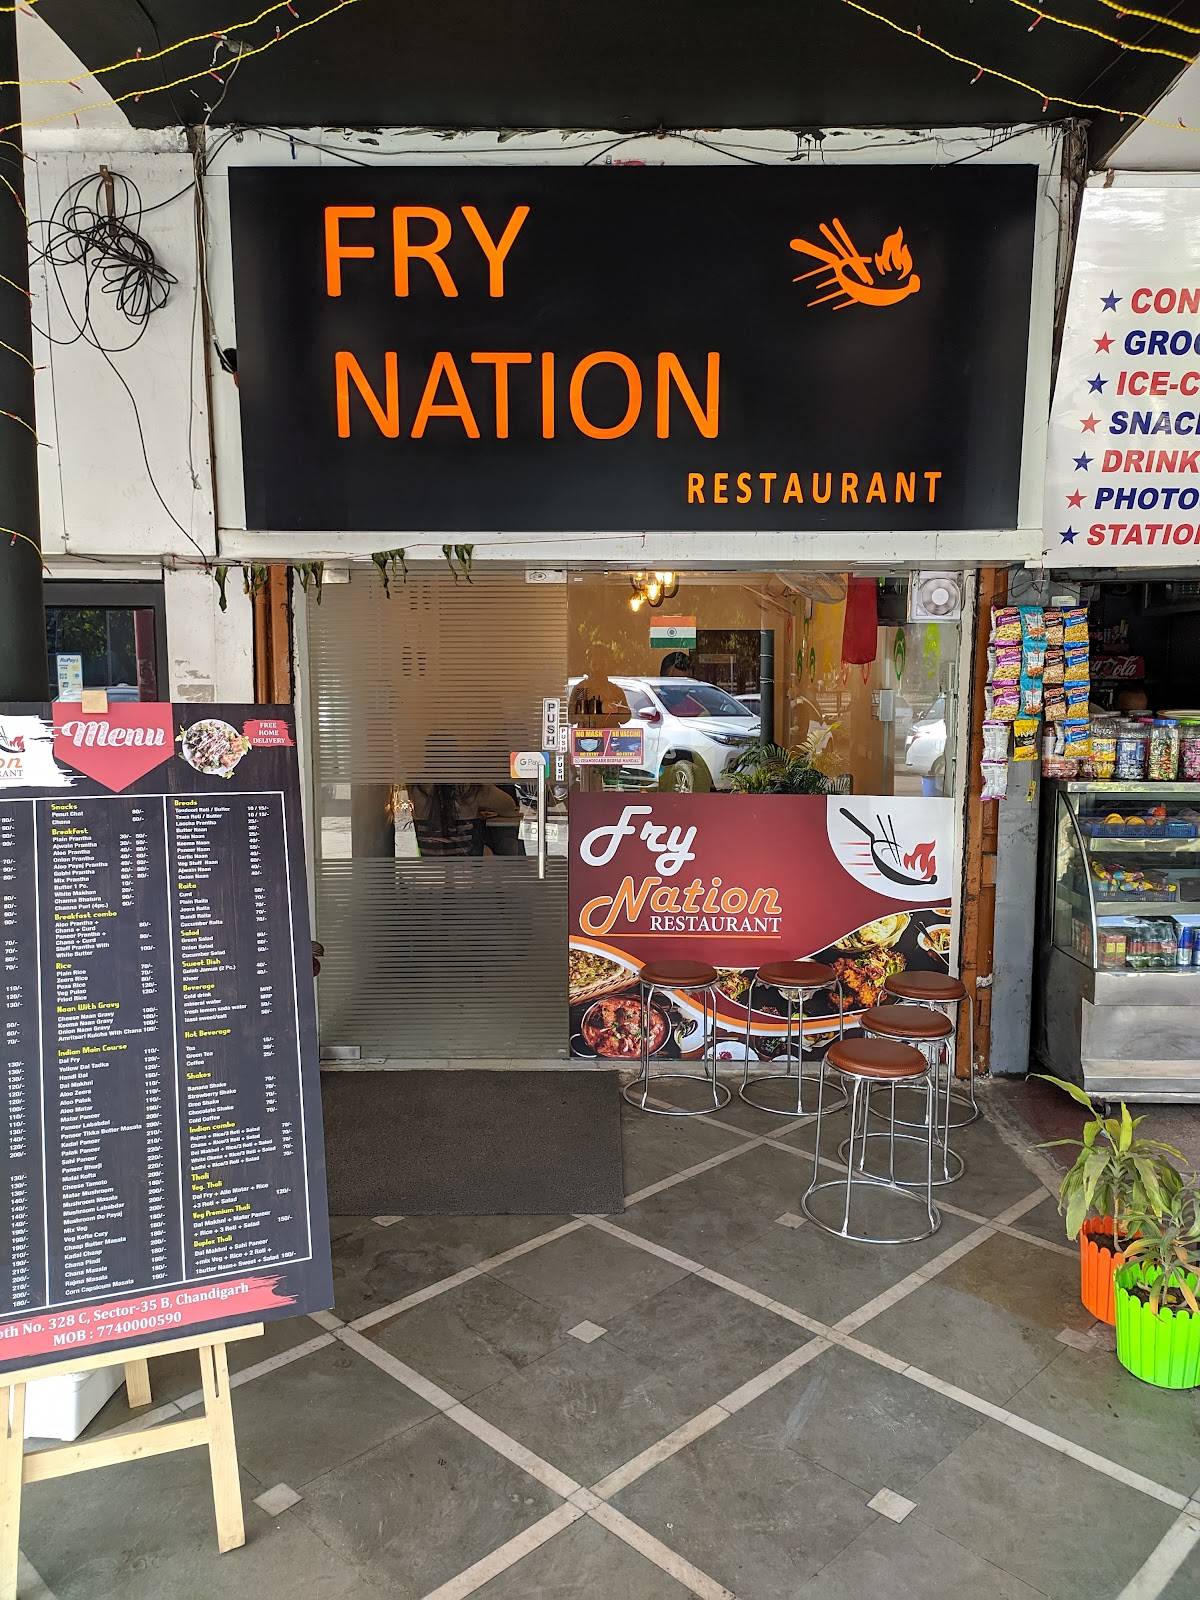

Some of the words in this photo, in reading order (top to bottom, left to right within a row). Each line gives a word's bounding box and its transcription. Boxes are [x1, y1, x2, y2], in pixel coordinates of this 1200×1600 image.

[324, 205, 531, 299] FRY
[334, 351, 722, 439] NATION
[1109, 411, 1200, 435] SNAC
[687, 471, 943, 504] RESTAURANT
[1094, 487, 1200, 509] PHOTO
[547, 703, 555, 746] PUSH
[61, 720, 166, 747] Menu
[580, 806, 697, 876] Fry
[178, 882, 197, 890] Raita
[579, 876, 782, 936] Nation
[54, 912, 92, 921] Breakfast
[649, 916, 782, 933] RESTAURANT
[181, 929, 200, 937] Salad
[183, 984, 215, 992] Beverage
[78, 1003, 96, 1011] With
[185, 1031, 197, 1039] Hot
[199, 1029, 231, 1037] Beverage
[58, 1049, 80, 1057] Indian
[82, 1046, 100, 1054] Main
[187, 1072, 211, 1080] Shakes
[212, 1121, 236, 1129] combo
[192, 1172, 209, 1181] Thali
[193, 1212, 205, 1220] Veg
[206, 1208, 234, 1217] Premium
[193, 1239, 215, 1247] Duplex
[217, 1235, 233, 1243] Thali
[263, 1254, 279, 1262] Salad
[22, 1322, 45, 1337] No.
[48, 1315, 75, 1330] 328
[78, 1312, 91, 1326] C,
[93, 1300, 158, 1322] Sector-35
[160, 1297, 173, 1312] B,
[176, 1282, 250, 1307] Chandigarh
[53, 1331, 86, 1346] MOB
[97, 1312, 182, 1338] 7740000590
